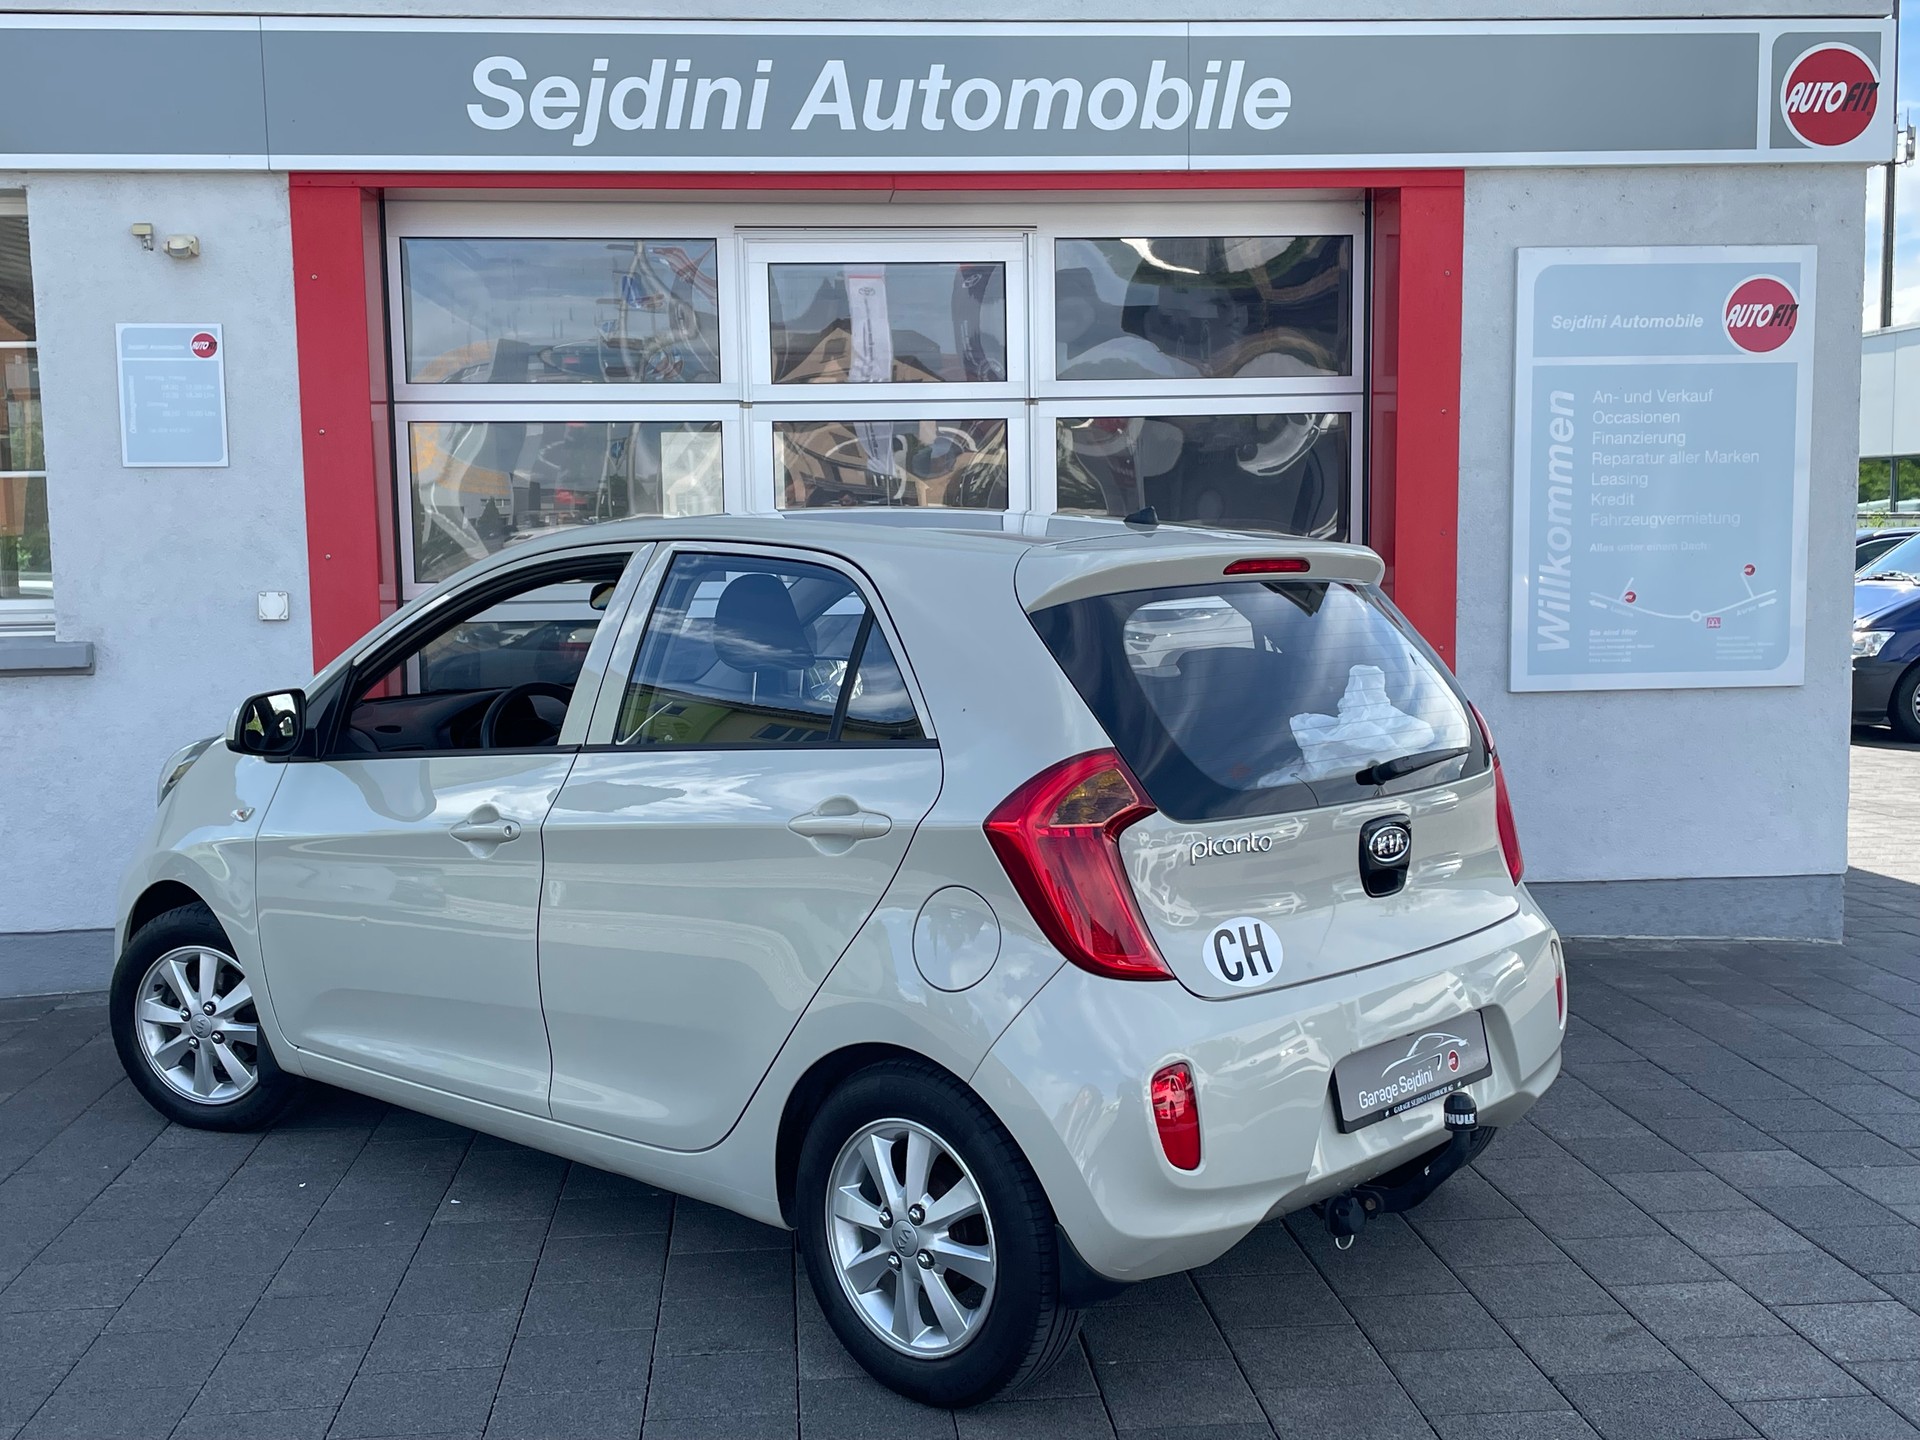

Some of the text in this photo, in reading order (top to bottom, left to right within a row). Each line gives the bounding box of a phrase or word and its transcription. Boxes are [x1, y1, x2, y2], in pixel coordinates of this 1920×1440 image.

[467, 56, 1292, 146] Sejdini Automobile
[1786, 81, 1881, 114] AUTOFIT
[1551, 313, 1704, 332] Sejdini Automobile
[1726, 303, 1799, 328] AUTOFIT
[1593, 388, 1714, 404] An- und Verkauf
[1592, 410, 1680, 424] Occasionen
[1592, 430, 1686, 447] Finanzierung
[1591, 449, 1760, 468] Reparatur aller Marken
[1591, 472, 1649, 488] Leasing
[1591, 493, 1635, 506] Kredit
[1537, 389, 1575, 651] Willkommen
[1590, 511, 1742, 529] Fahrzeugvermietung
[1589, 543, 1614, 552] Alles
[1189, 832, 1273, 866] picanto
[1376, 833, 1405, 856] KIA
[1213, 923, 1273, 982] CH
[1358, 1066, 1434, 1109] Garage Sejdini
[895, 1229, 911, 1253] KIA
